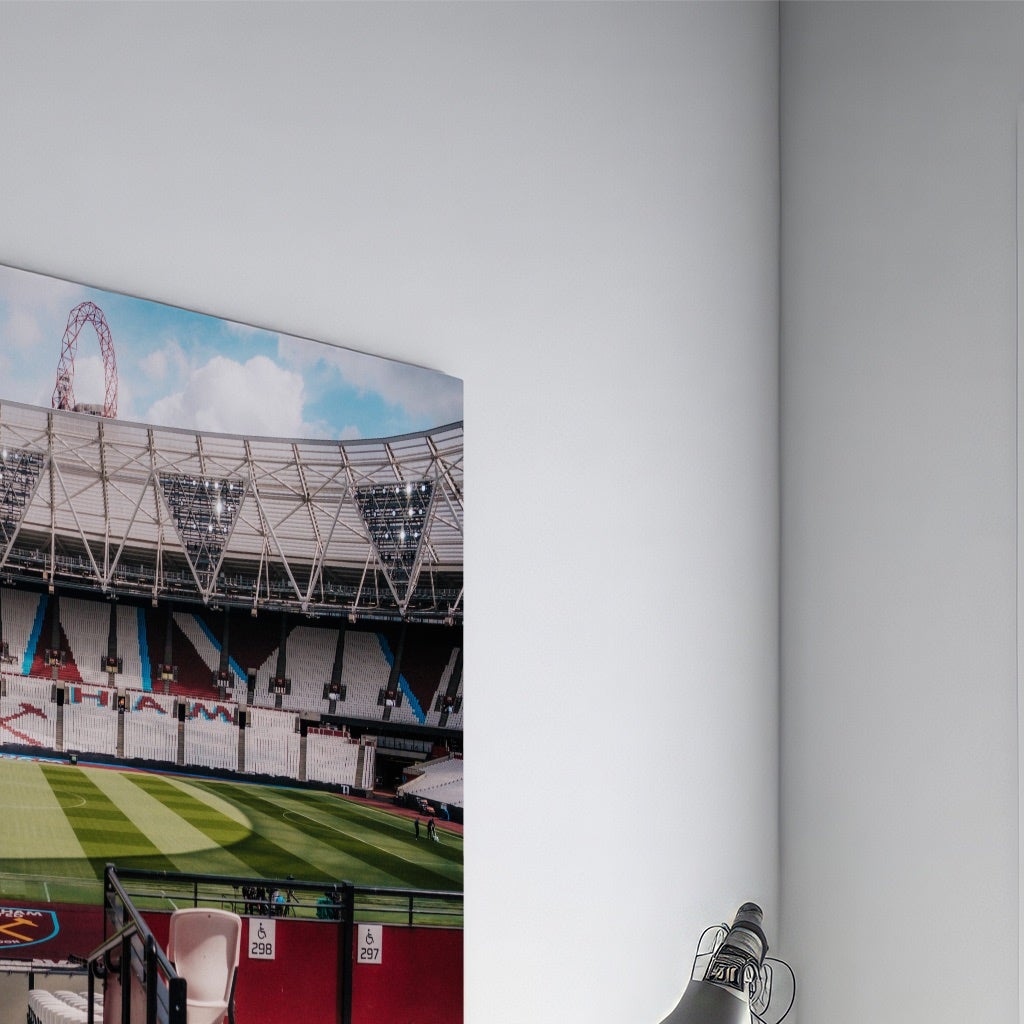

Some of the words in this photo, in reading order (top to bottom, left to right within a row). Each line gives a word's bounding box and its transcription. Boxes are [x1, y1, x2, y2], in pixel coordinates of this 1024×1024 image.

[70, 686, 235, 723] HAM
[251, 942, 273, 956] 298
[360, 947, 379, 960] 297
